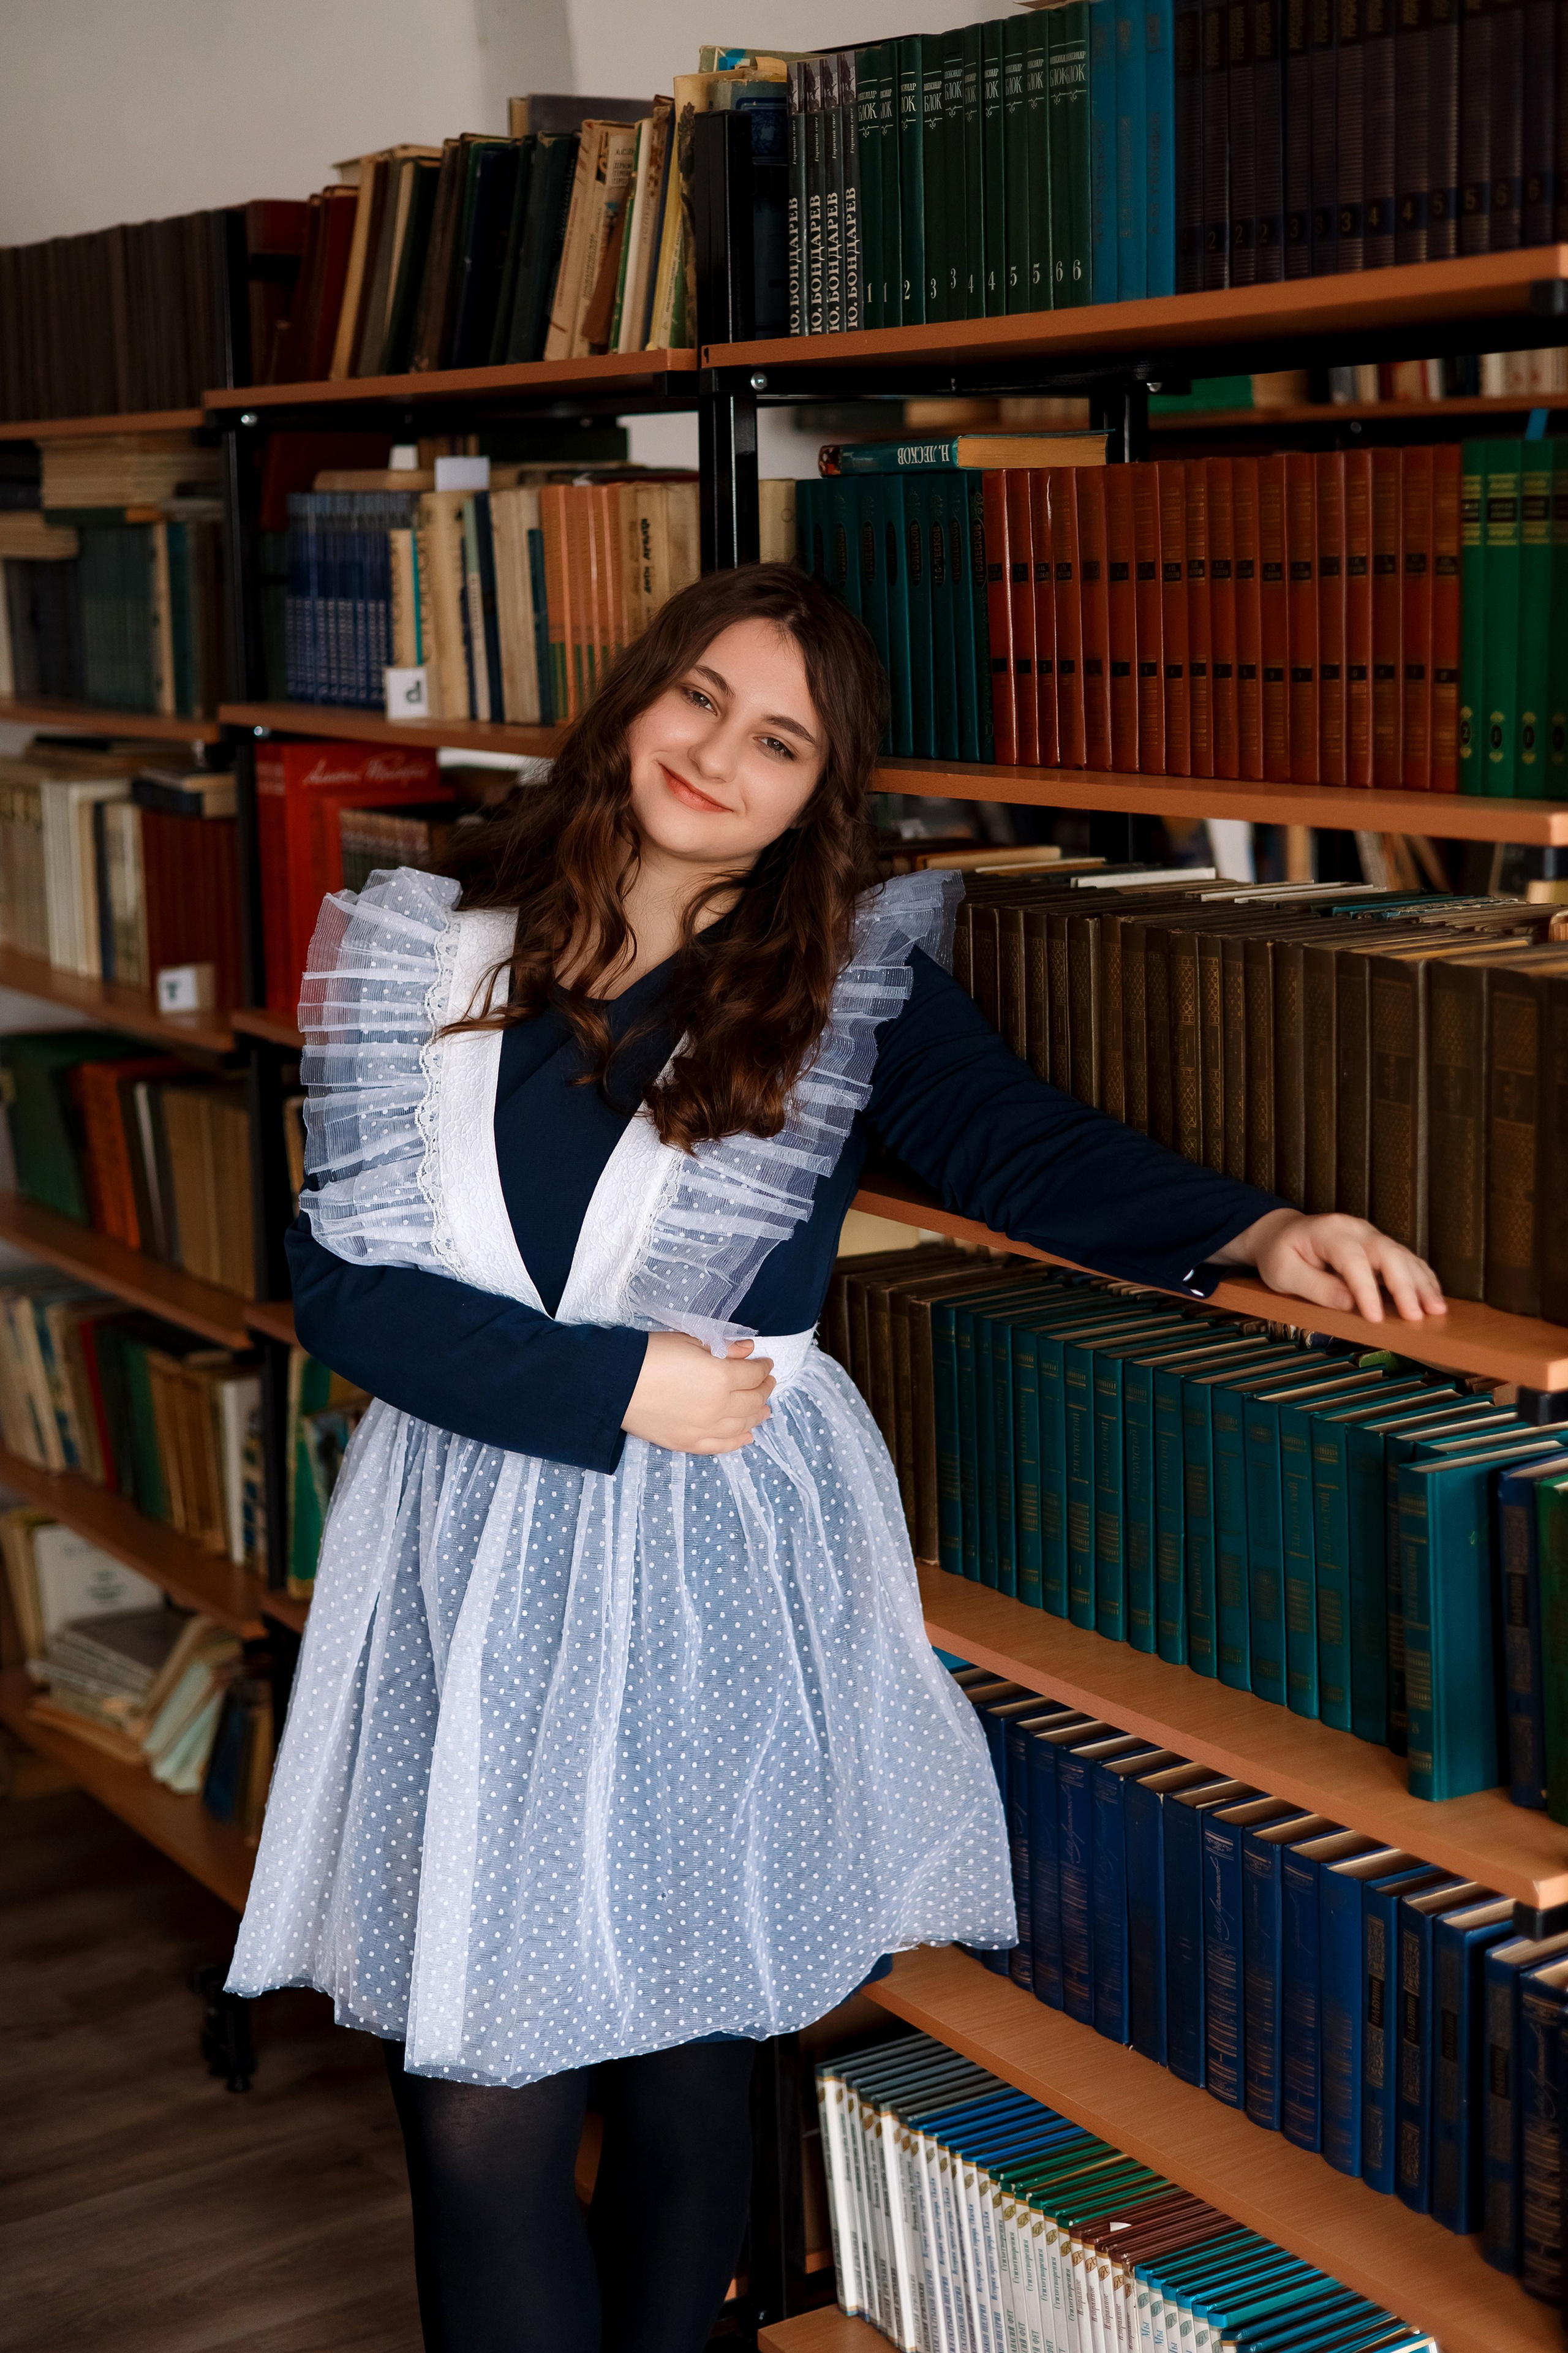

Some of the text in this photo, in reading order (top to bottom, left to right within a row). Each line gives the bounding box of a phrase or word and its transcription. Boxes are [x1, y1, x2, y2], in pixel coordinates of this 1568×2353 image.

[944, 81, 963, 100] БЛОК
[985, 80, 998, 100] ЛОК
[880, 101, 892, 119] ЛОК
[924, 93, 942, 112] БЛОК
[1341, 211, 1351, 232] 3
[1209, 230, 1217, 249] 2
[1235, 224, 1243, 243] 2
[1259, 224, 1268, 243] 2
[788, 197, 802, 334] Ю. БОНДАРЕВ
[810, 195, 825, 334] Ю. БОНДАРЕВ
[827, 192, 842, 331] Ю. БОНДАРЕВ
[846, 187, 860, 328] Ю. БОНДАРЕВ
[951, 268, 956, 289] 3
[1010, 266, 1017, 286] 5
[1033, 263, 1040, 284] 5
[1056, 261, 1063, 282] 6
[1072, 260, 1081, 280] 6
[904, 280, 911, 300] 2
[930, 278, 937, 298] 3
[968, 274, 974, 293] 4
[988, 271, 995, 290] 4
[867, 283, 872, 303] 1
[883, 282, 888, 302] 1
[897, 444, 949, 465] Н. ЛЕСКОВ
[999, 2219, 1008, 2272] Стихотворения
[1011, 2232, 1020, 2284] Стихотворения
[1076, 2279, 1084, 2316] Избранное
[1089, 2285, 1098, 2322] Избранное
[1006, 2309, 1015, 2324] ФЕТ
[1102, 2294, 1112, 2330] Избранное
[1116, 2304, 1125, 2341] Избранное
[1141, 2321, 1151, 2338] Мы
[1155, 2330, 1164, 2346] Мы
